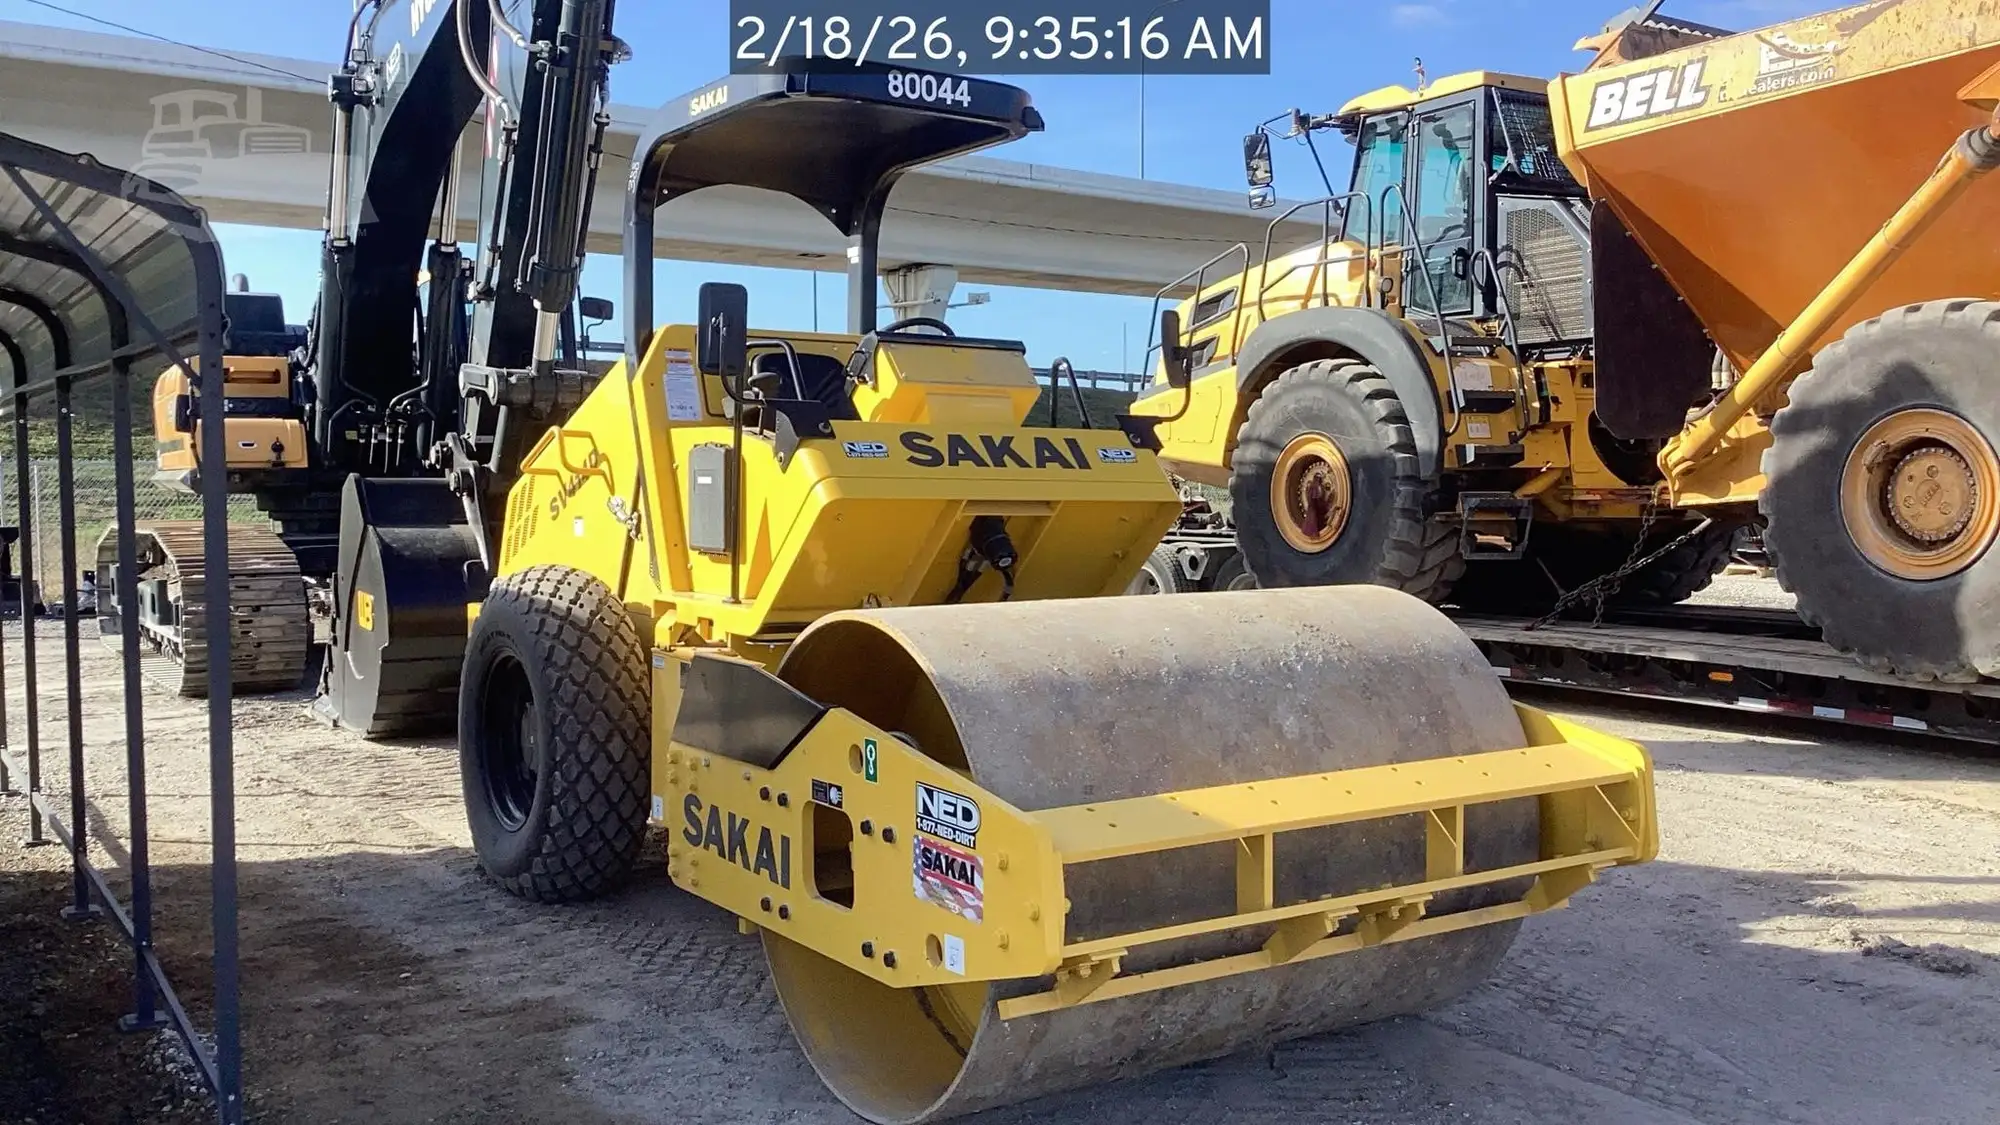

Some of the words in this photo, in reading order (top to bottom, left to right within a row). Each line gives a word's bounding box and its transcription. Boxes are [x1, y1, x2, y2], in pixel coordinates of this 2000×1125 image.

[690, 85, 728, 116] SAKAI
[888, 69, 971, 107] 80044
[1586, 59, 1708, 129] BELL
[1719, 65, 1836, 102] ealers.com
[842, 441, 888, 453] NED
[899, 431, 1092, 470] SAKAI
[1097, 448, 1135, 458] NED
[917, 784, 980, 831] NED
[683, 793, 790, 890] SAKAI
[917, 817, 976, 848] 1-877-NED-DIRT
[920, 846, 976, 887] SAKAI
